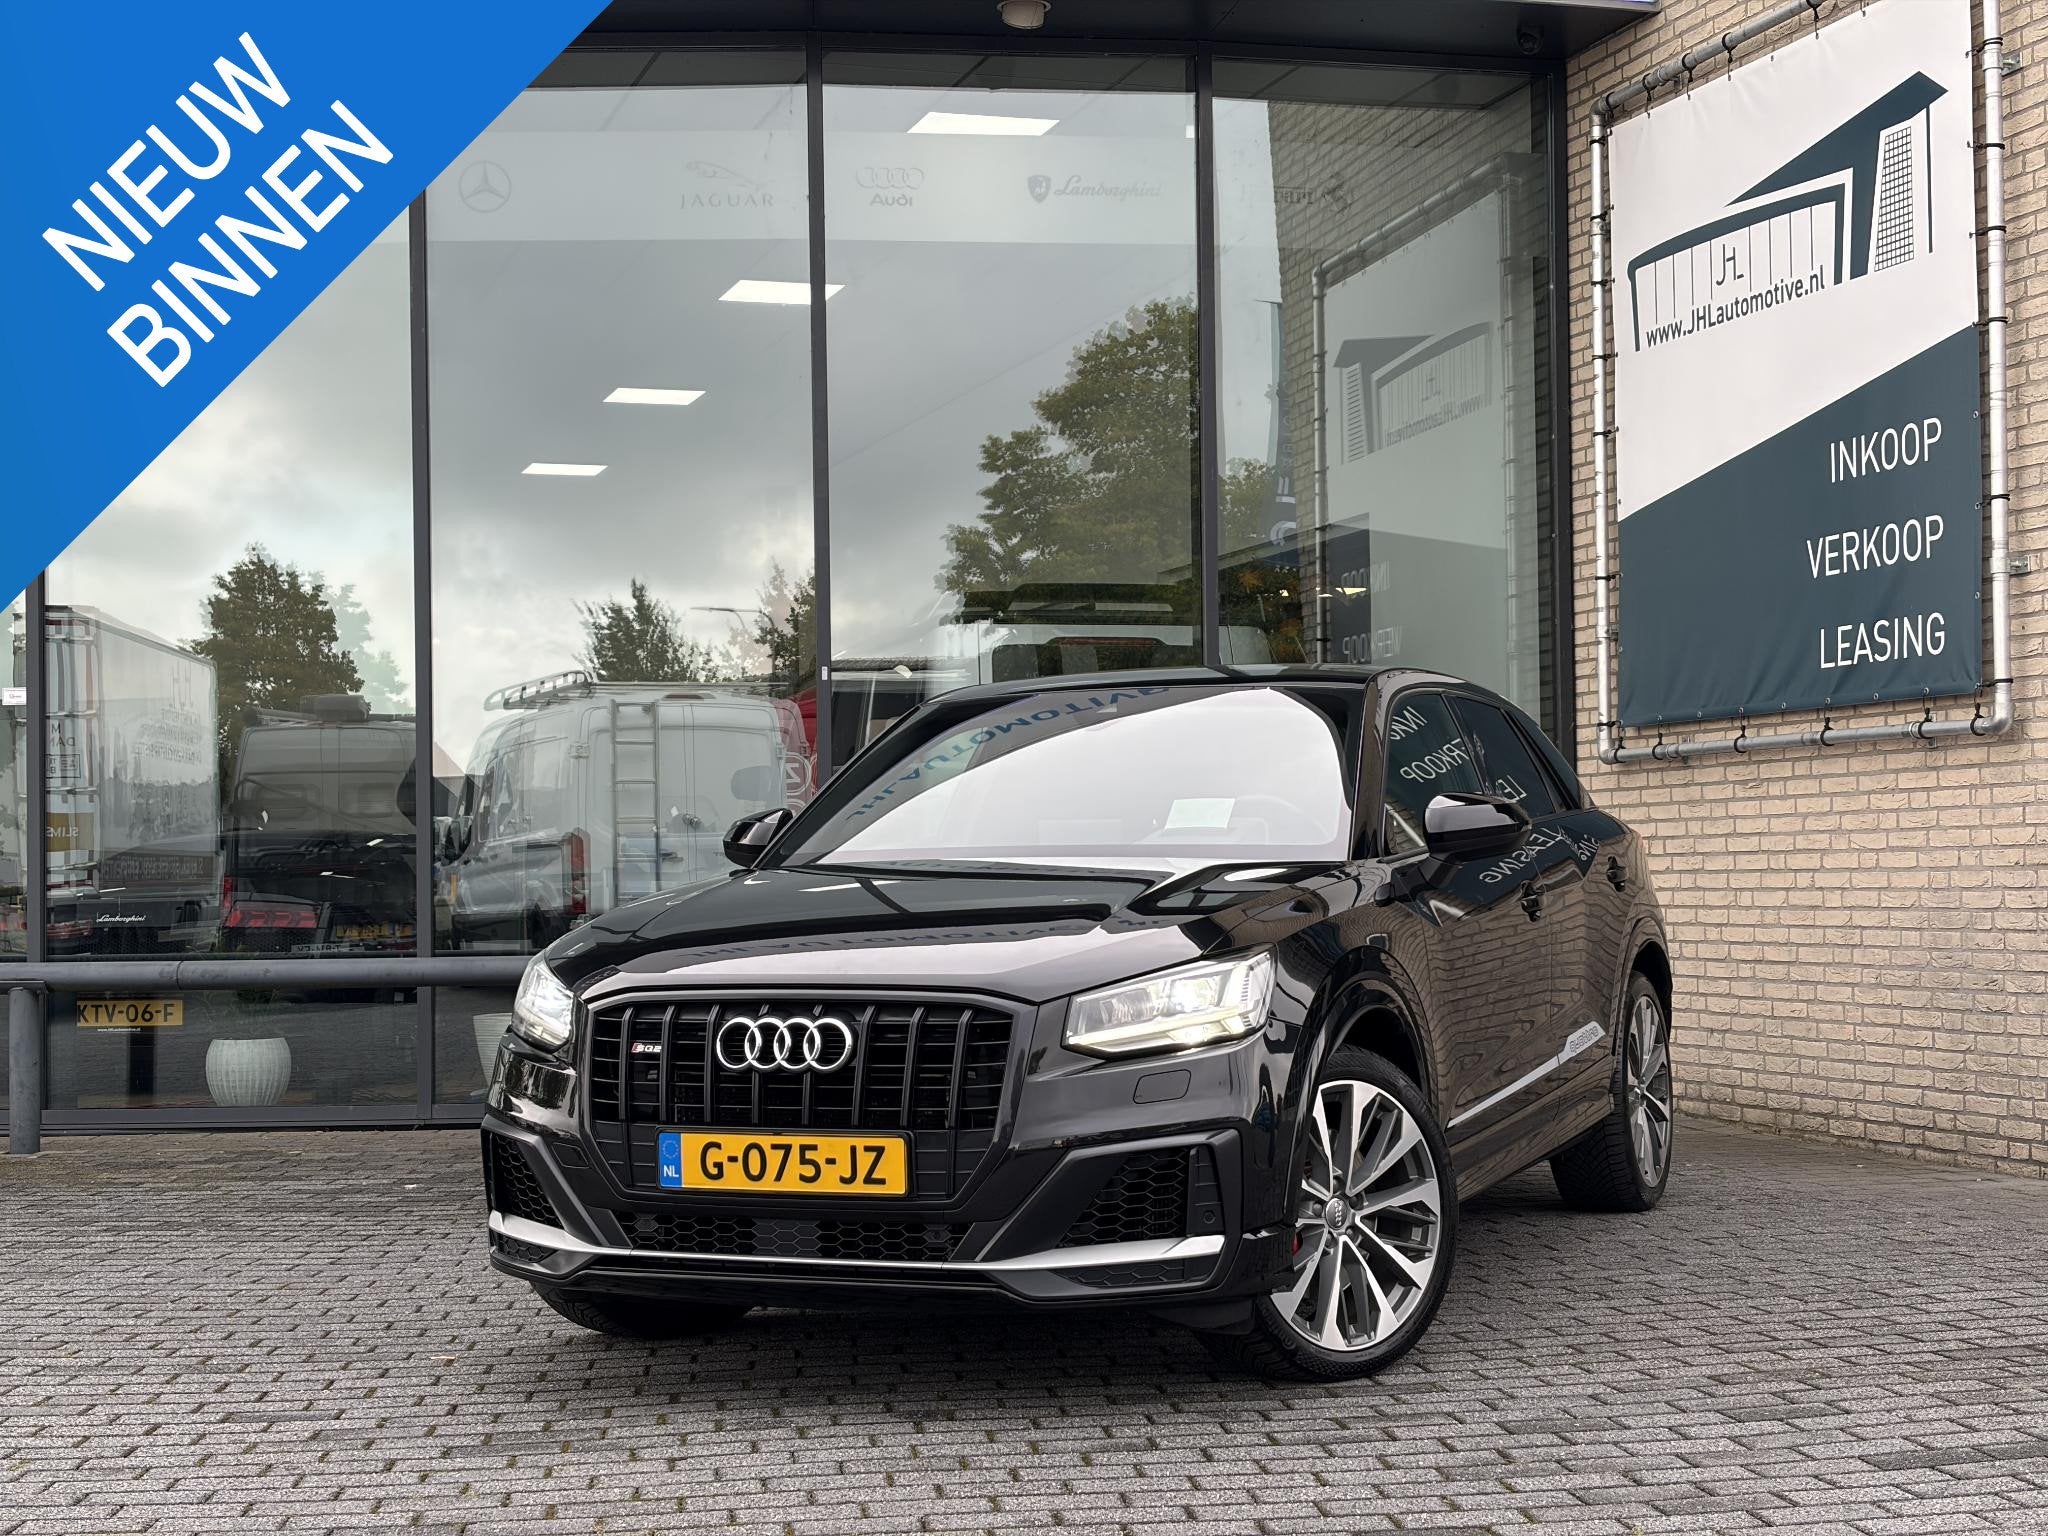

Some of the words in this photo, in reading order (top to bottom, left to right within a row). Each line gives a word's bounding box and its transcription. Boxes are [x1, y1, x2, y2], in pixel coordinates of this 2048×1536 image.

[680, 192, 774, 209] JAGUAR
[869, 194, 913, 207] Audi
[1053, 175, 1163, 202] Lamborghini
[1715, 243, 1745, 286] JHL
[1646, 264, 1825, 348] www.JHLautomotive.nl
[1830, 417, 1942, 484] INKOOP
[1806, 514, 1944, 579] VERKOOP
[1820, 612, 1945, 669] LEASING
[77, 1003, 176, 1024] KTV-06-F
[631, 1042, 662, 1053] SQ2
[663, 1164, 680, 1178] NL
[699, 1141, 887, 1186] G-075-JZ
